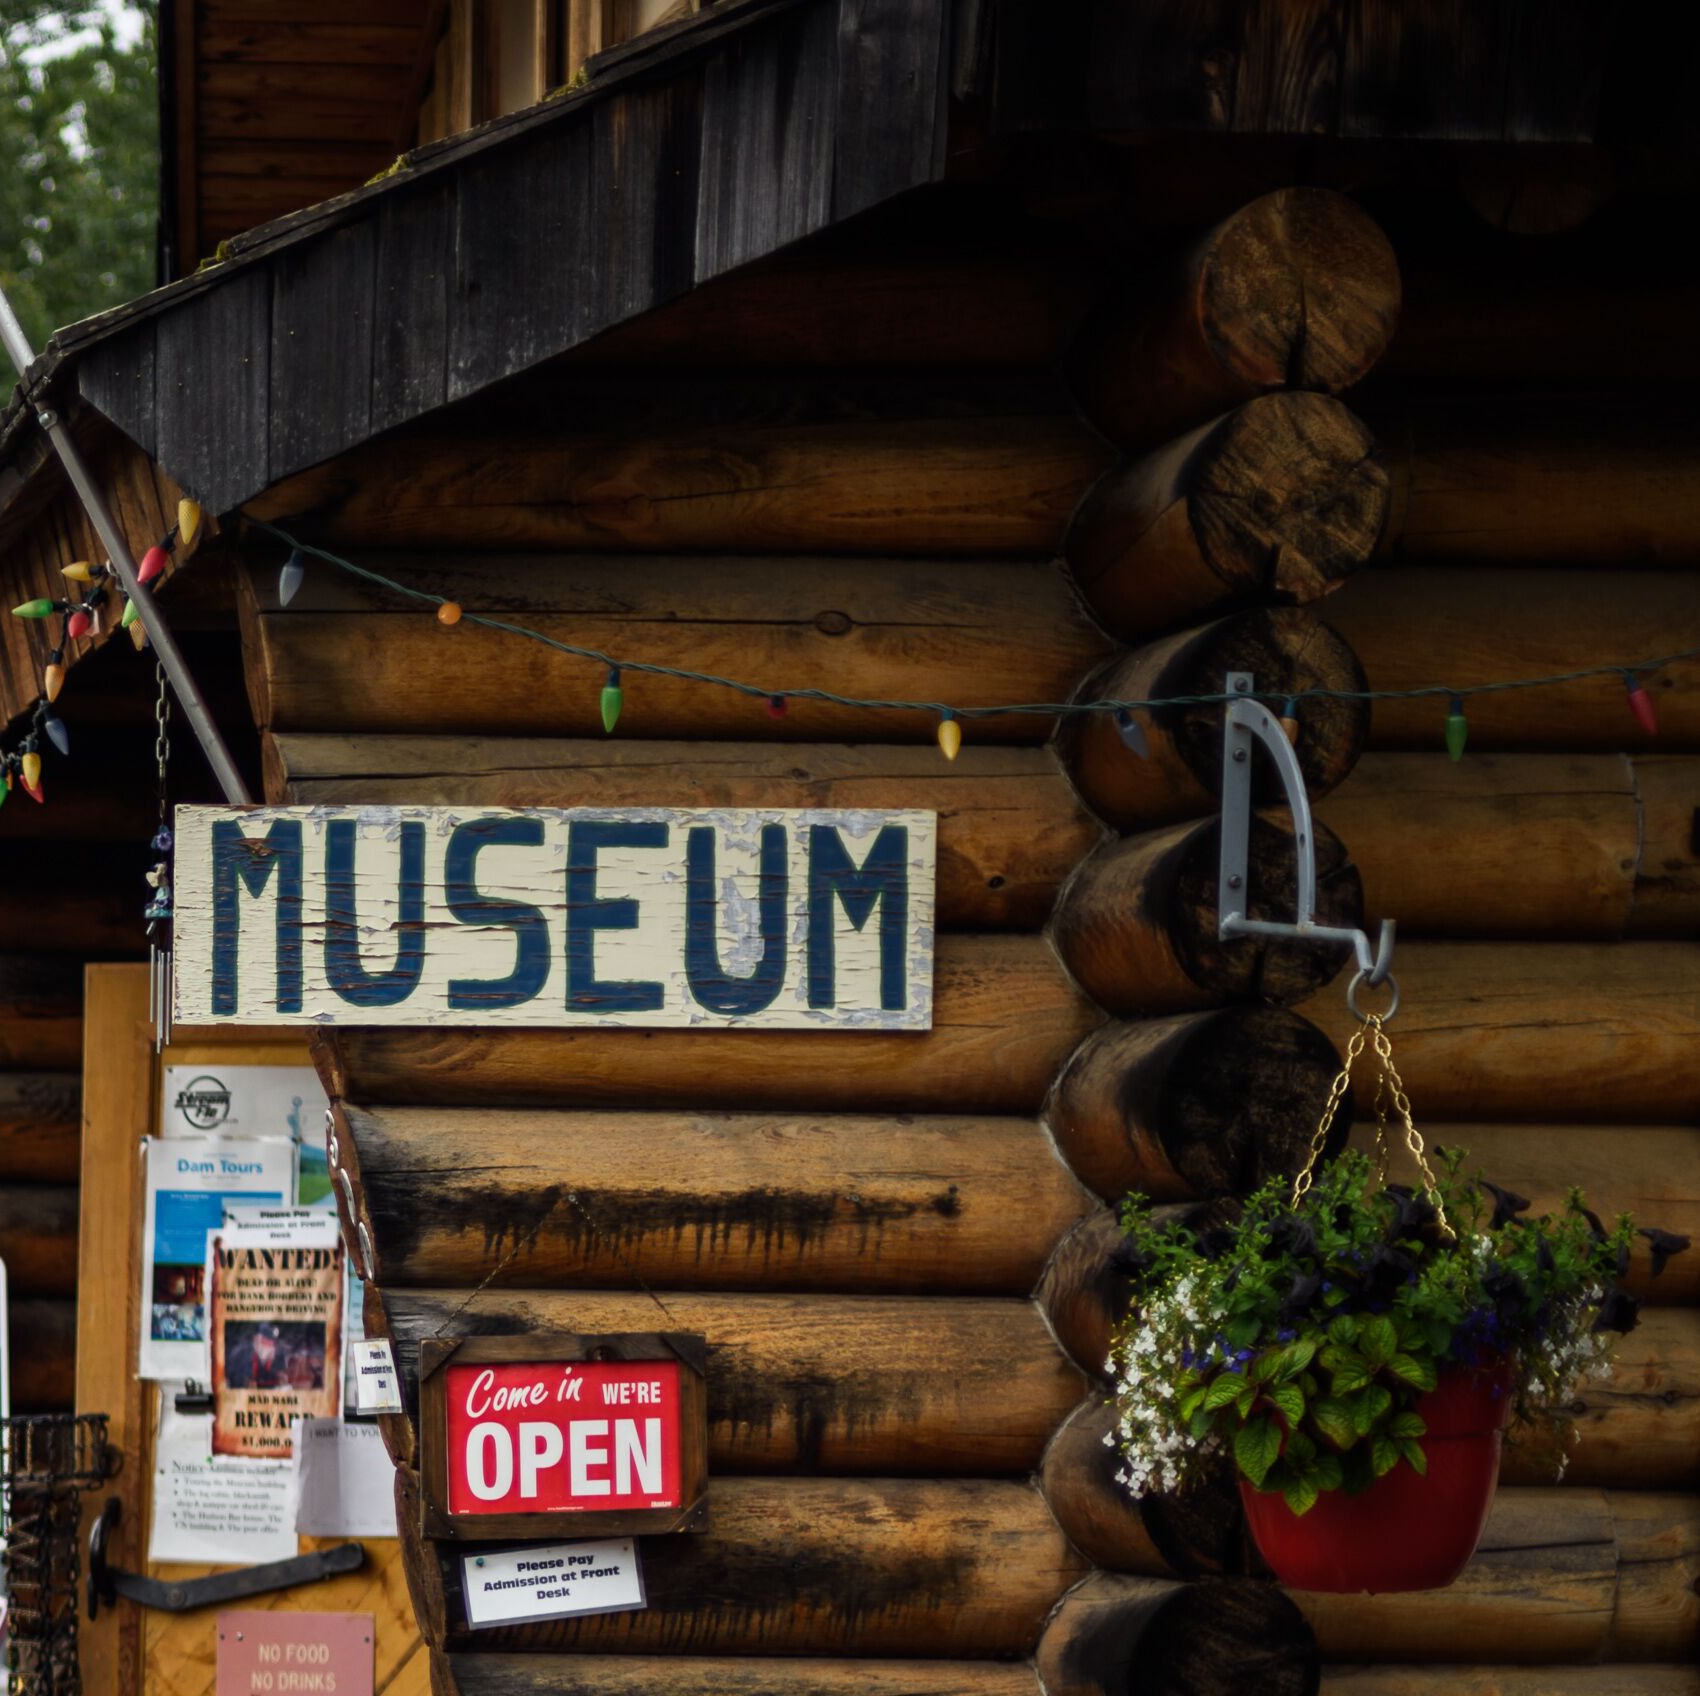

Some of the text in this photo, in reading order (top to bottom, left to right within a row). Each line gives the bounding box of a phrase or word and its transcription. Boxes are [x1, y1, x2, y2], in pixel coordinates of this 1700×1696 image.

[211, 818, 907, 1016] MUSEUM
[177, 1158, 263, 1174] Dam Tours
[465, 1367, 661, 1418] Come in WE'RE
[466, 1418, 663, 1501] OPEN
[517, 1554, 594, 1572] Please Pay
[484, 1566, 620, 1591] Admission at Front
[537, 1587, 570, 1600] Desk
[258, 1643, 329, 1663] NO FOOD
[252, 1671, 336, 1691] NO DRINKS
